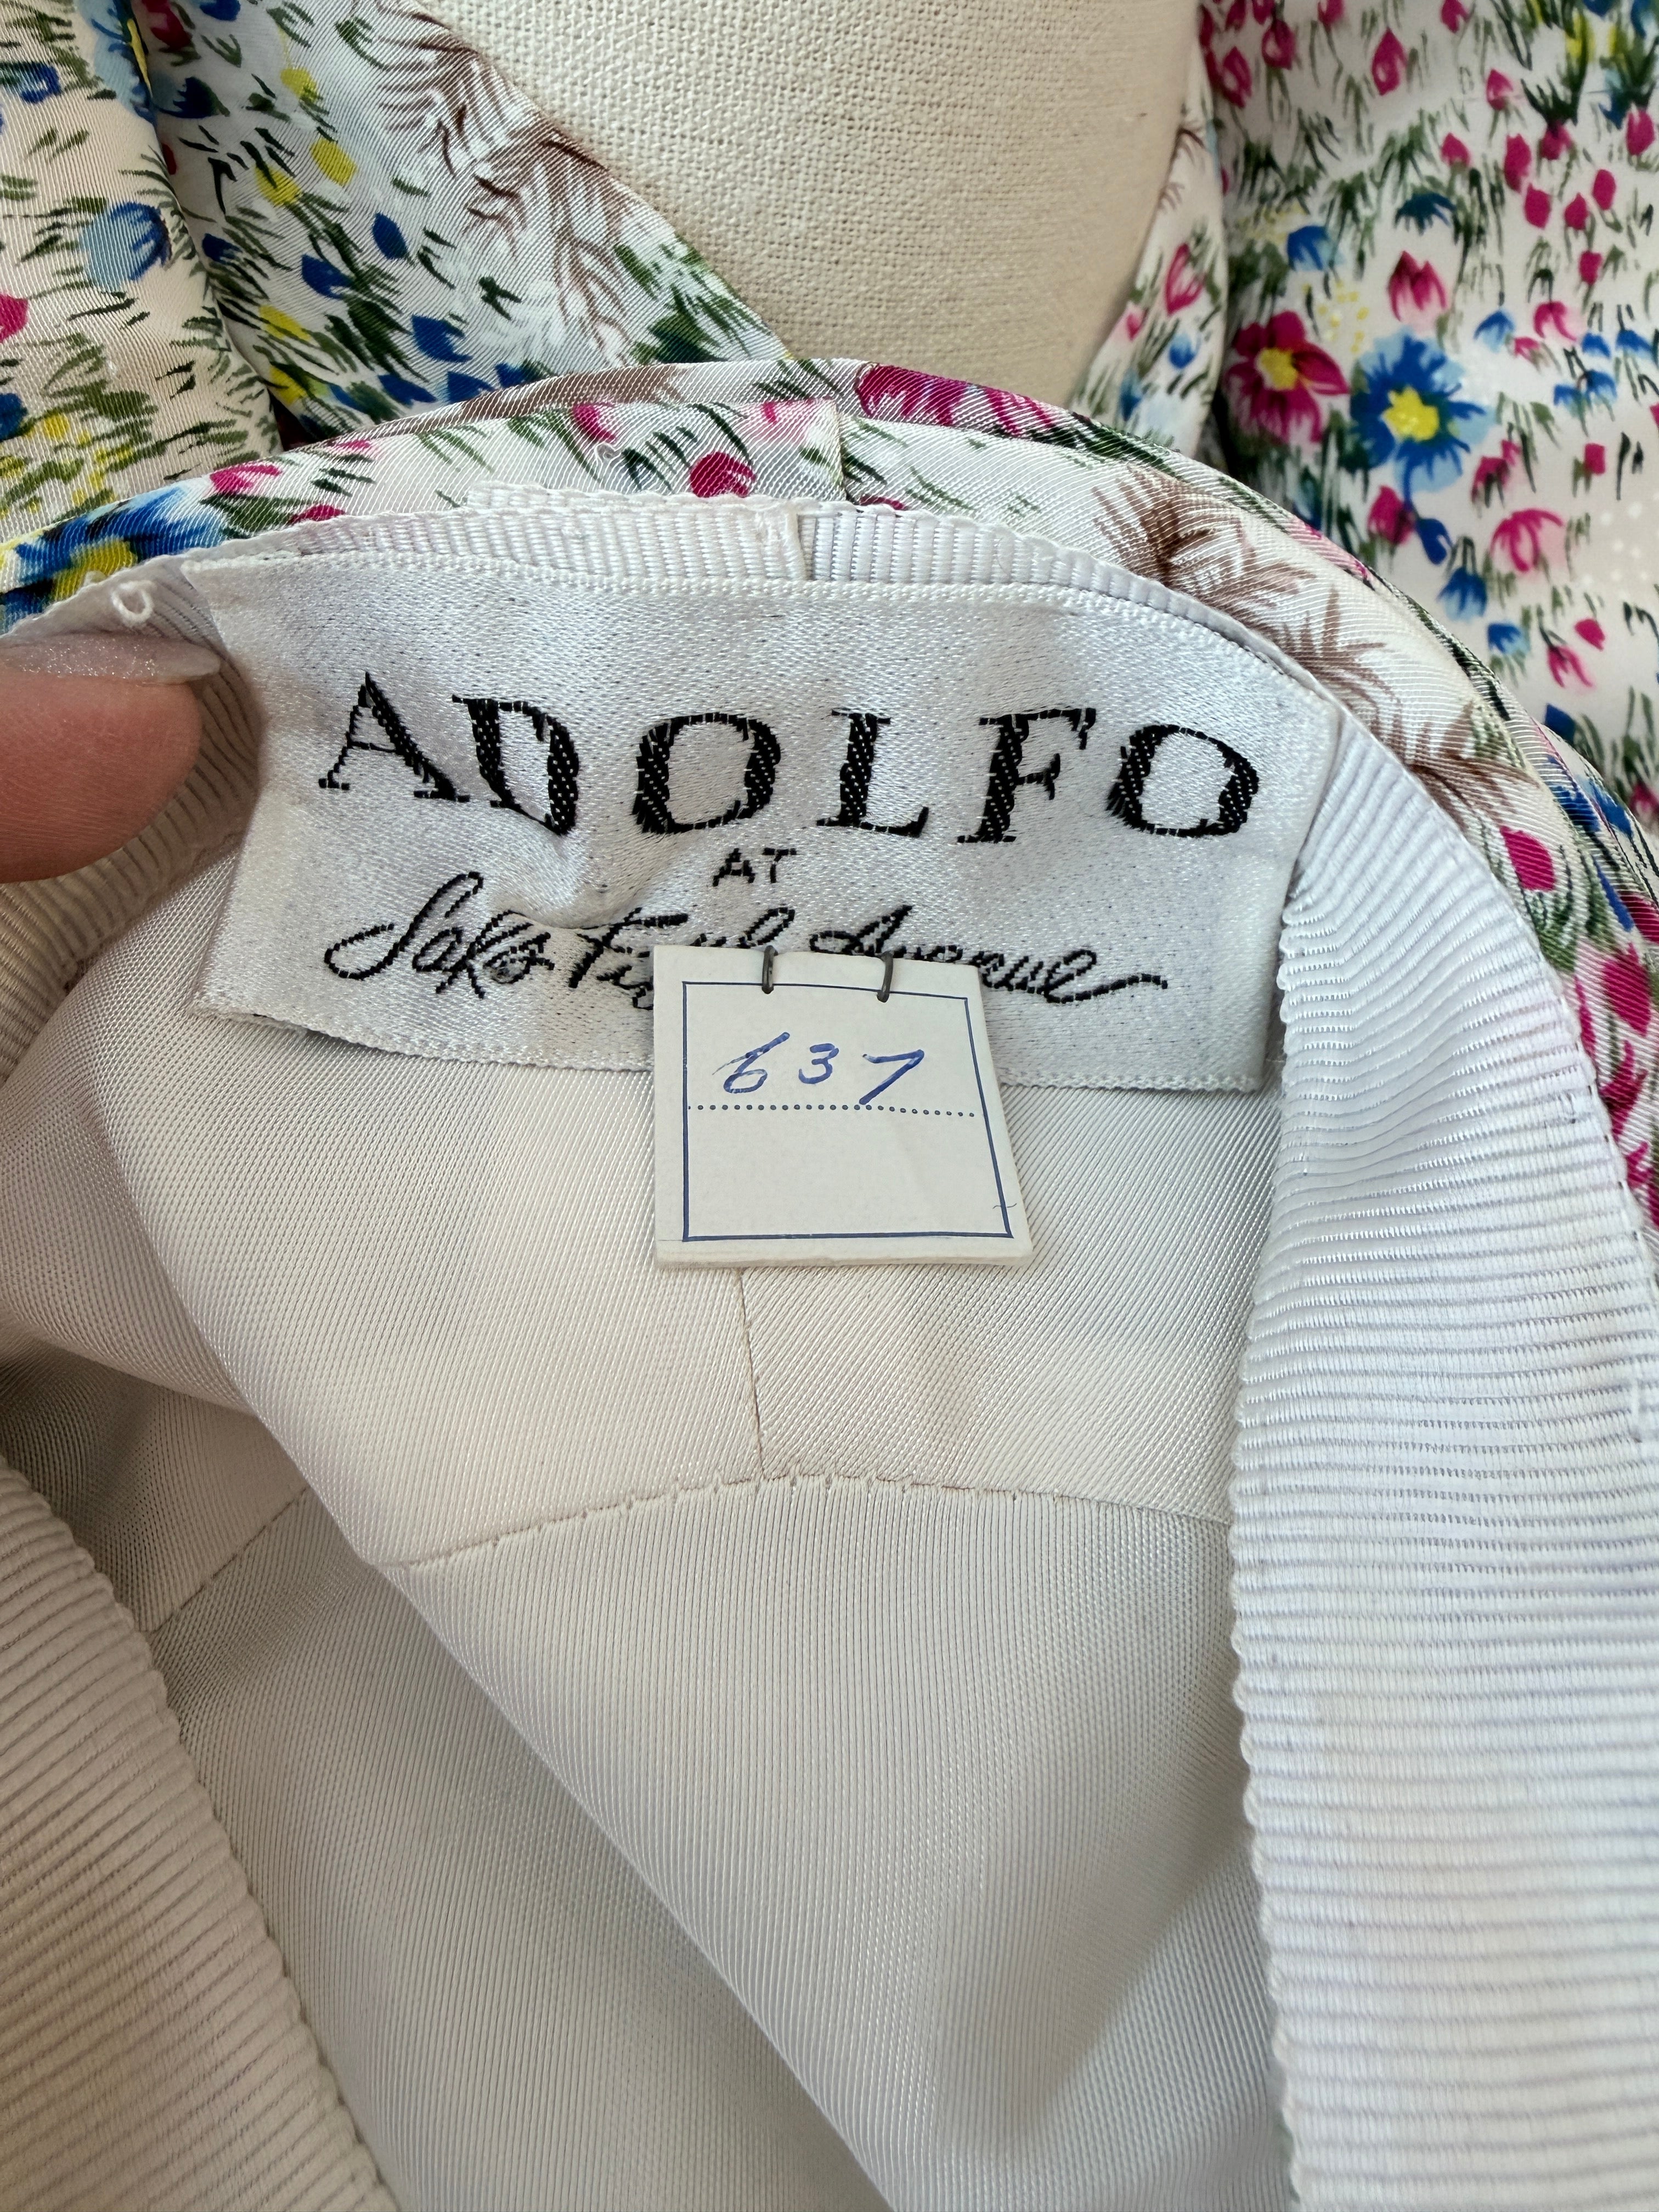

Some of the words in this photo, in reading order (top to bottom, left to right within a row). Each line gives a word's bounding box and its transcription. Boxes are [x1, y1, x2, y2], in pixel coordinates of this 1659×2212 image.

[318, 672, 1259, 842] ADOLFO
[712, 848, 797, 885] AT
[324, 871, 555, 998] Saks
[712, 1031, 925, 1105] 637
